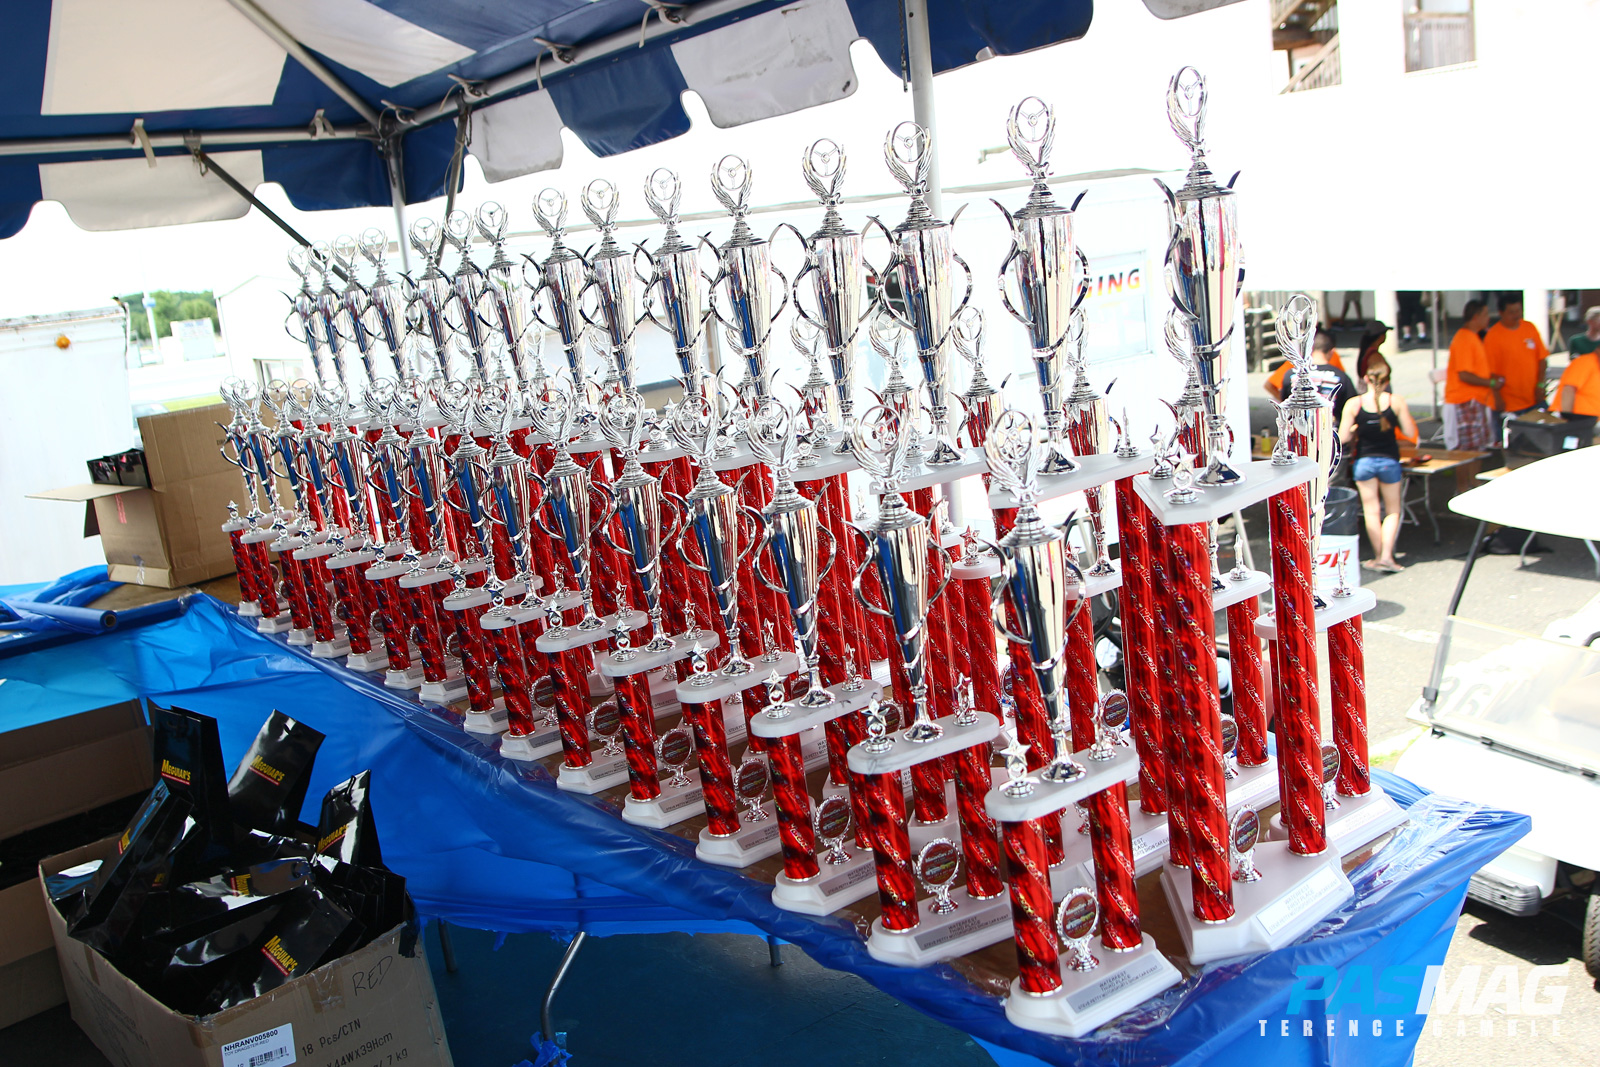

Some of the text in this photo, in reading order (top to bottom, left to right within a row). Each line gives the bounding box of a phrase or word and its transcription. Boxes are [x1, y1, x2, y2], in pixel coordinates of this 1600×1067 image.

[352, 955, 394, 997] RED
[224, 1030, 278, 1052] NHRANV005800
[302, 1018, 362, 1057] 18 Pcs/CTN
